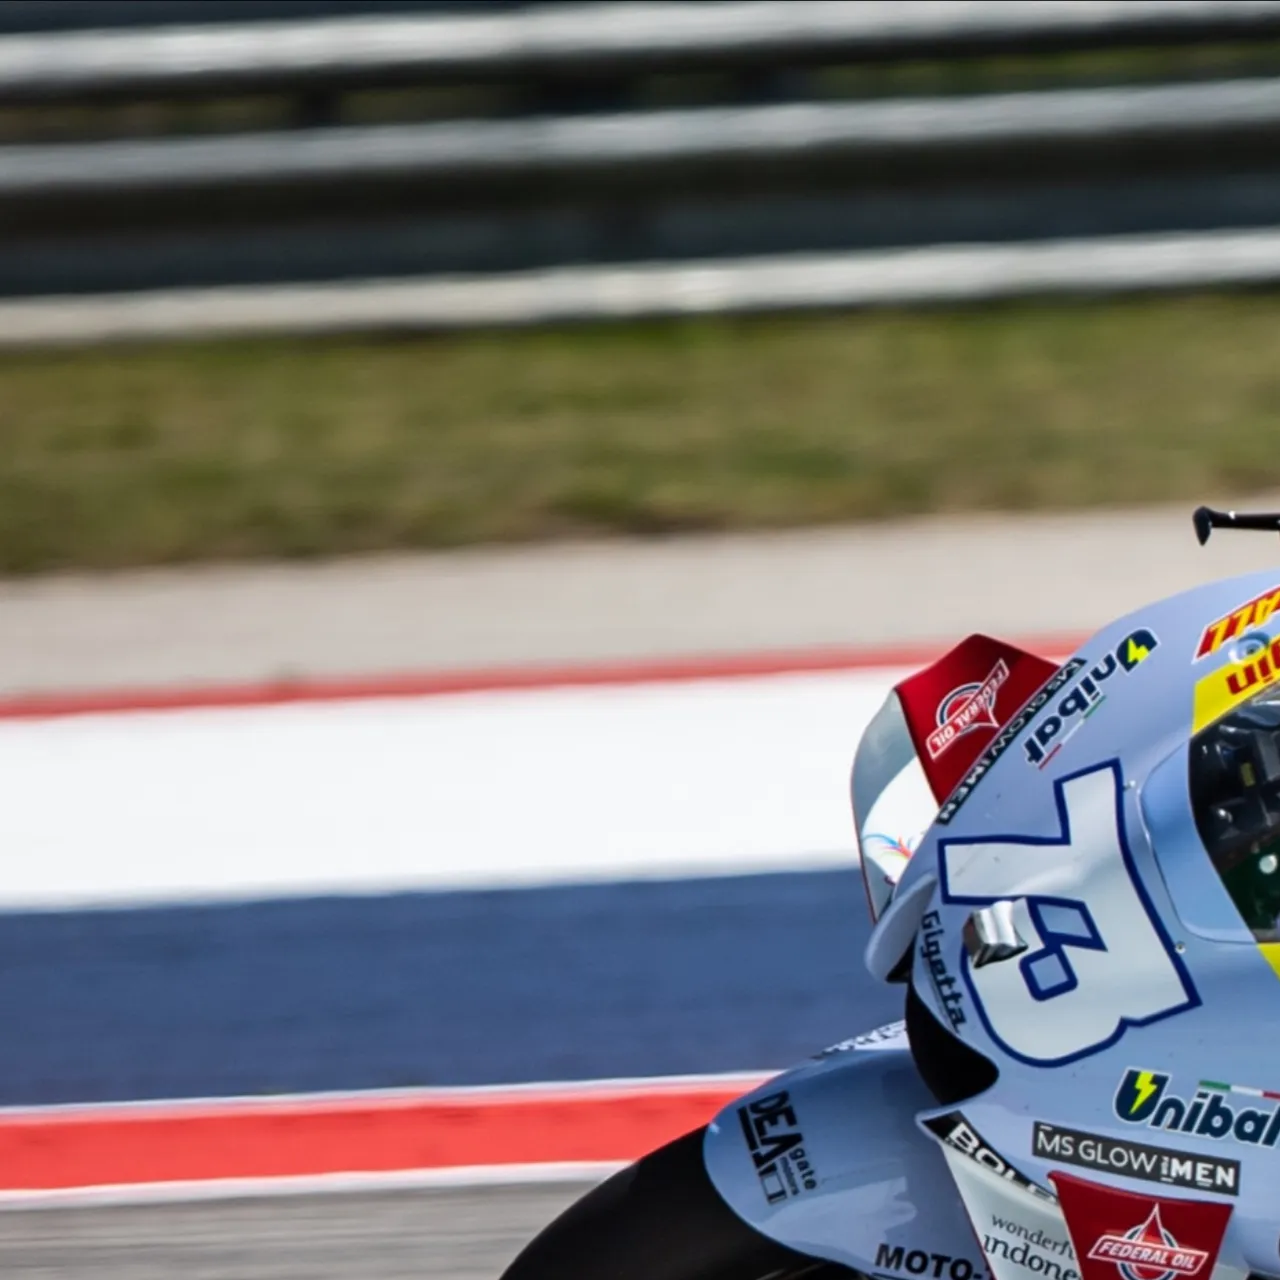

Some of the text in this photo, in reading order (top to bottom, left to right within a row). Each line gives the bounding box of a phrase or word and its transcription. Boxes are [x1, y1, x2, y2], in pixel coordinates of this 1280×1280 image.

[932, 667, 1006, 748] FEDERAL OIL
[1023, 629, 1158, 768] Unibat
[938, 757, 1203, 1069] 73
[748, 1089, 817, 1191] DEA gate
[1036, 1127, 1074, 1156] MS
[1078, 1139, 1158, 1173] GLOW
[1170, 1157, 1235, 1188] MEN
[1098, 1241, 1197, 1270] FEDERAL OIL
